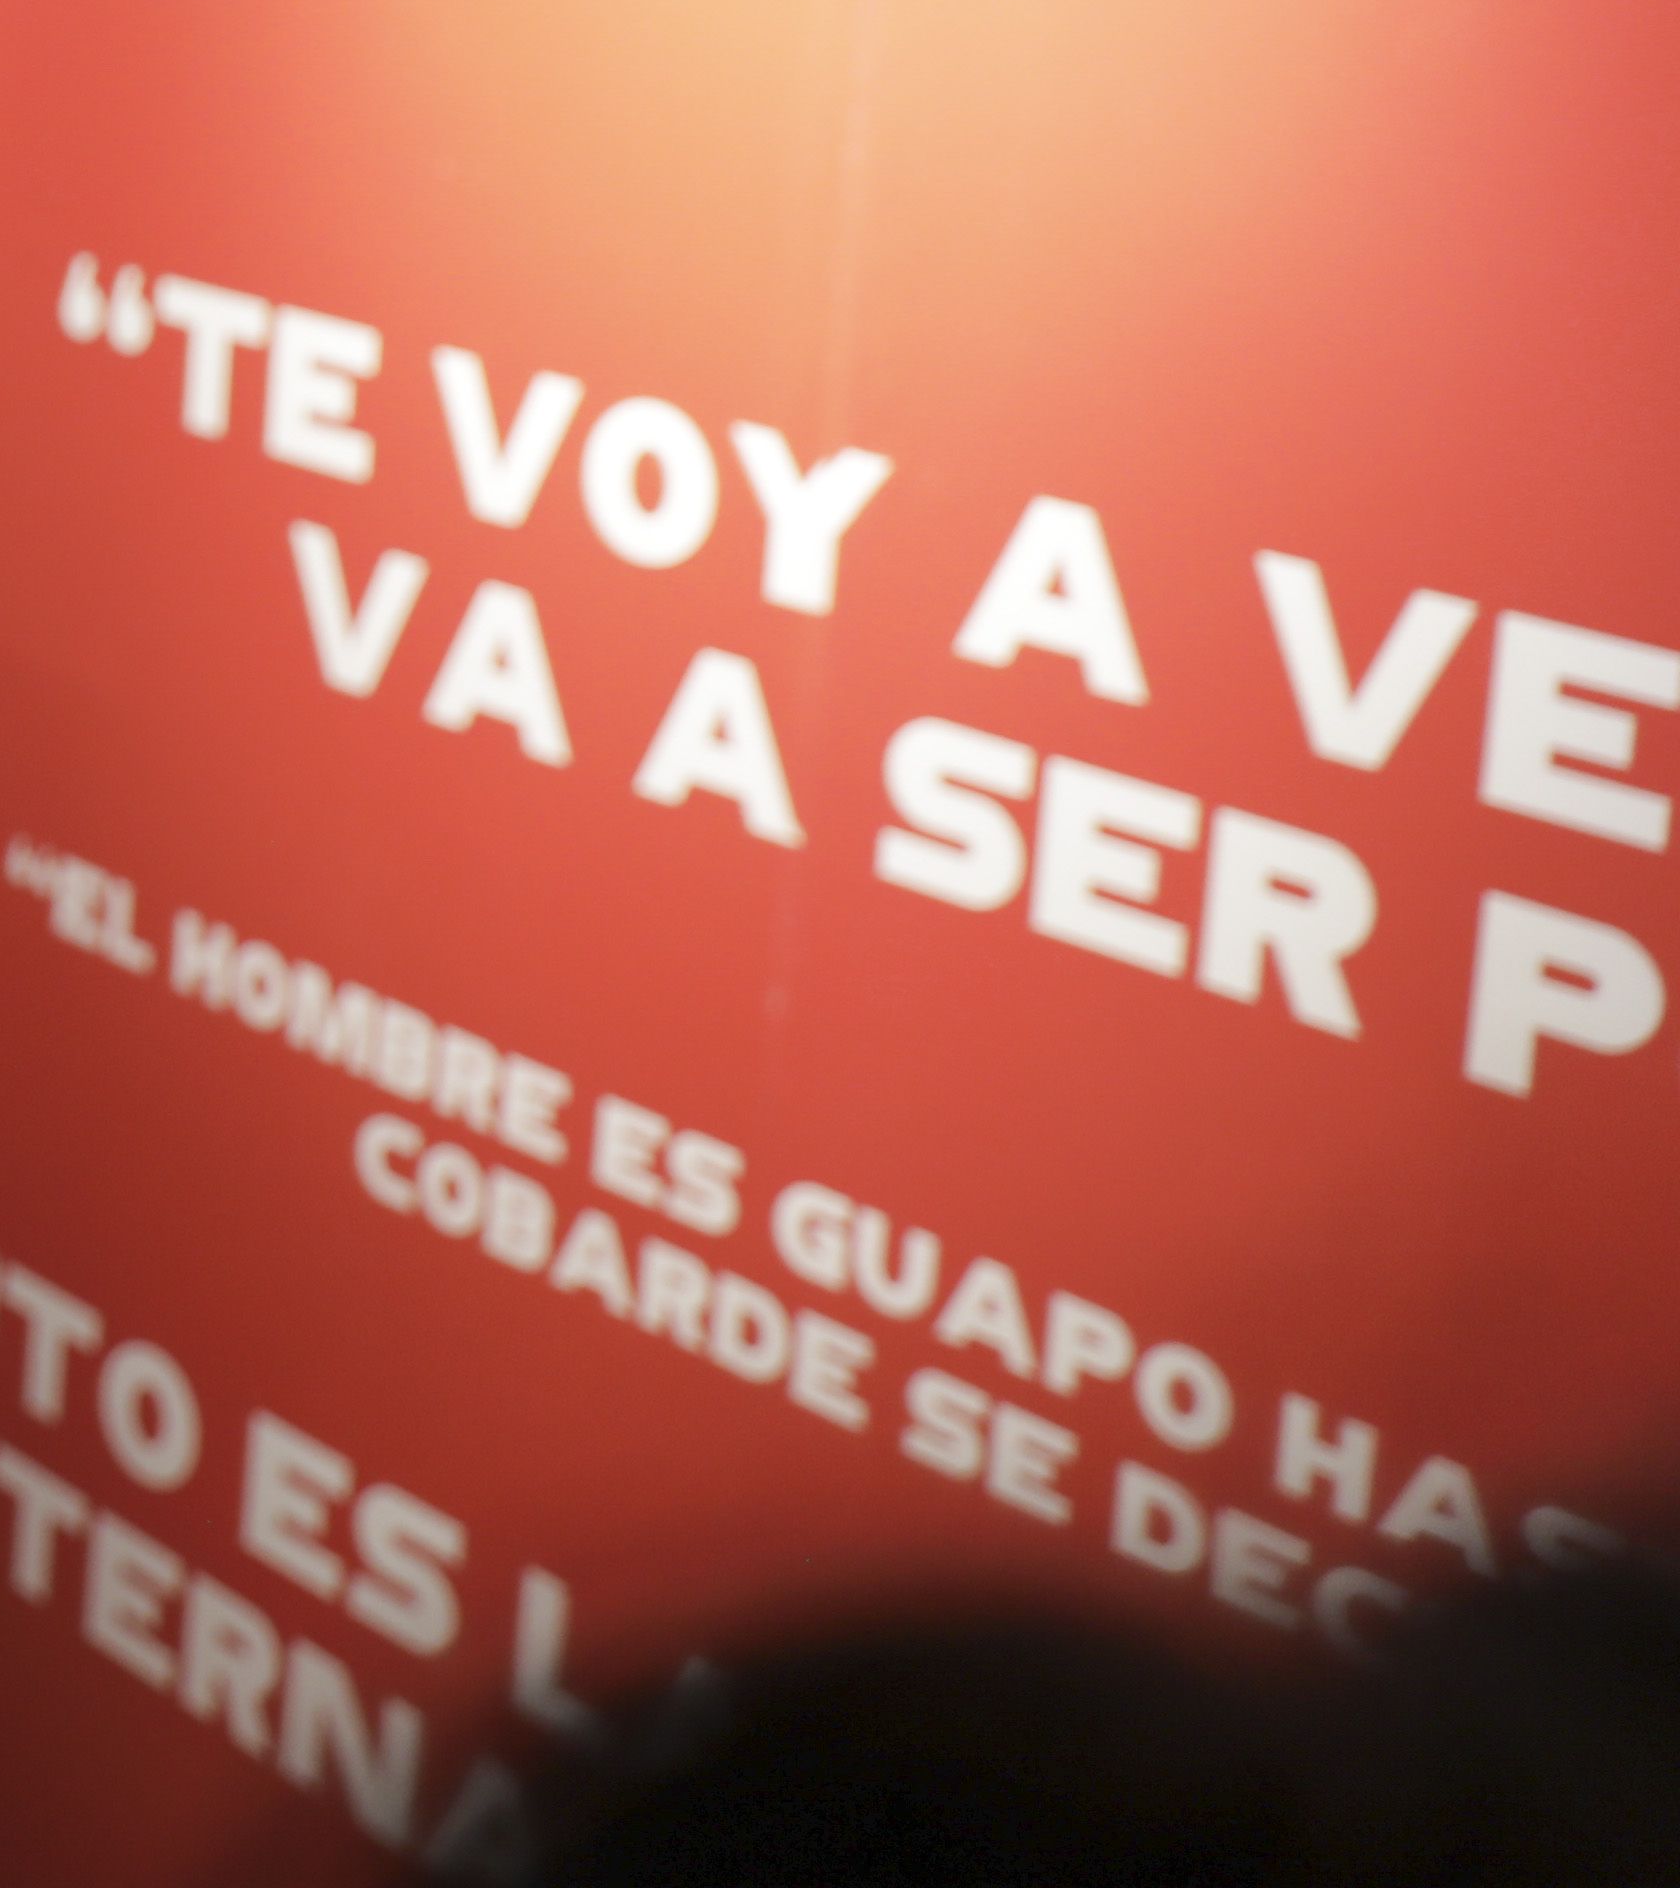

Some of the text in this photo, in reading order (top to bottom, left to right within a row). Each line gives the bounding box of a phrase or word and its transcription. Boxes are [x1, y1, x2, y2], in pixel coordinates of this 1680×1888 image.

[55, 249, 1680, 854] “TE VOY A VE
[289, 518, 1668, 1100] VA A SER P
[169, 905, 573, 1166] HOMBRE
[589, 1097, 744, 1235] ES
[771, 1179, 1237, 1454] GUAPO
[353, 1112, 878, 1434] COBARDE
[898, 1365, 1076, 1526] SE
[238, 1402, 470, 1662] ES
